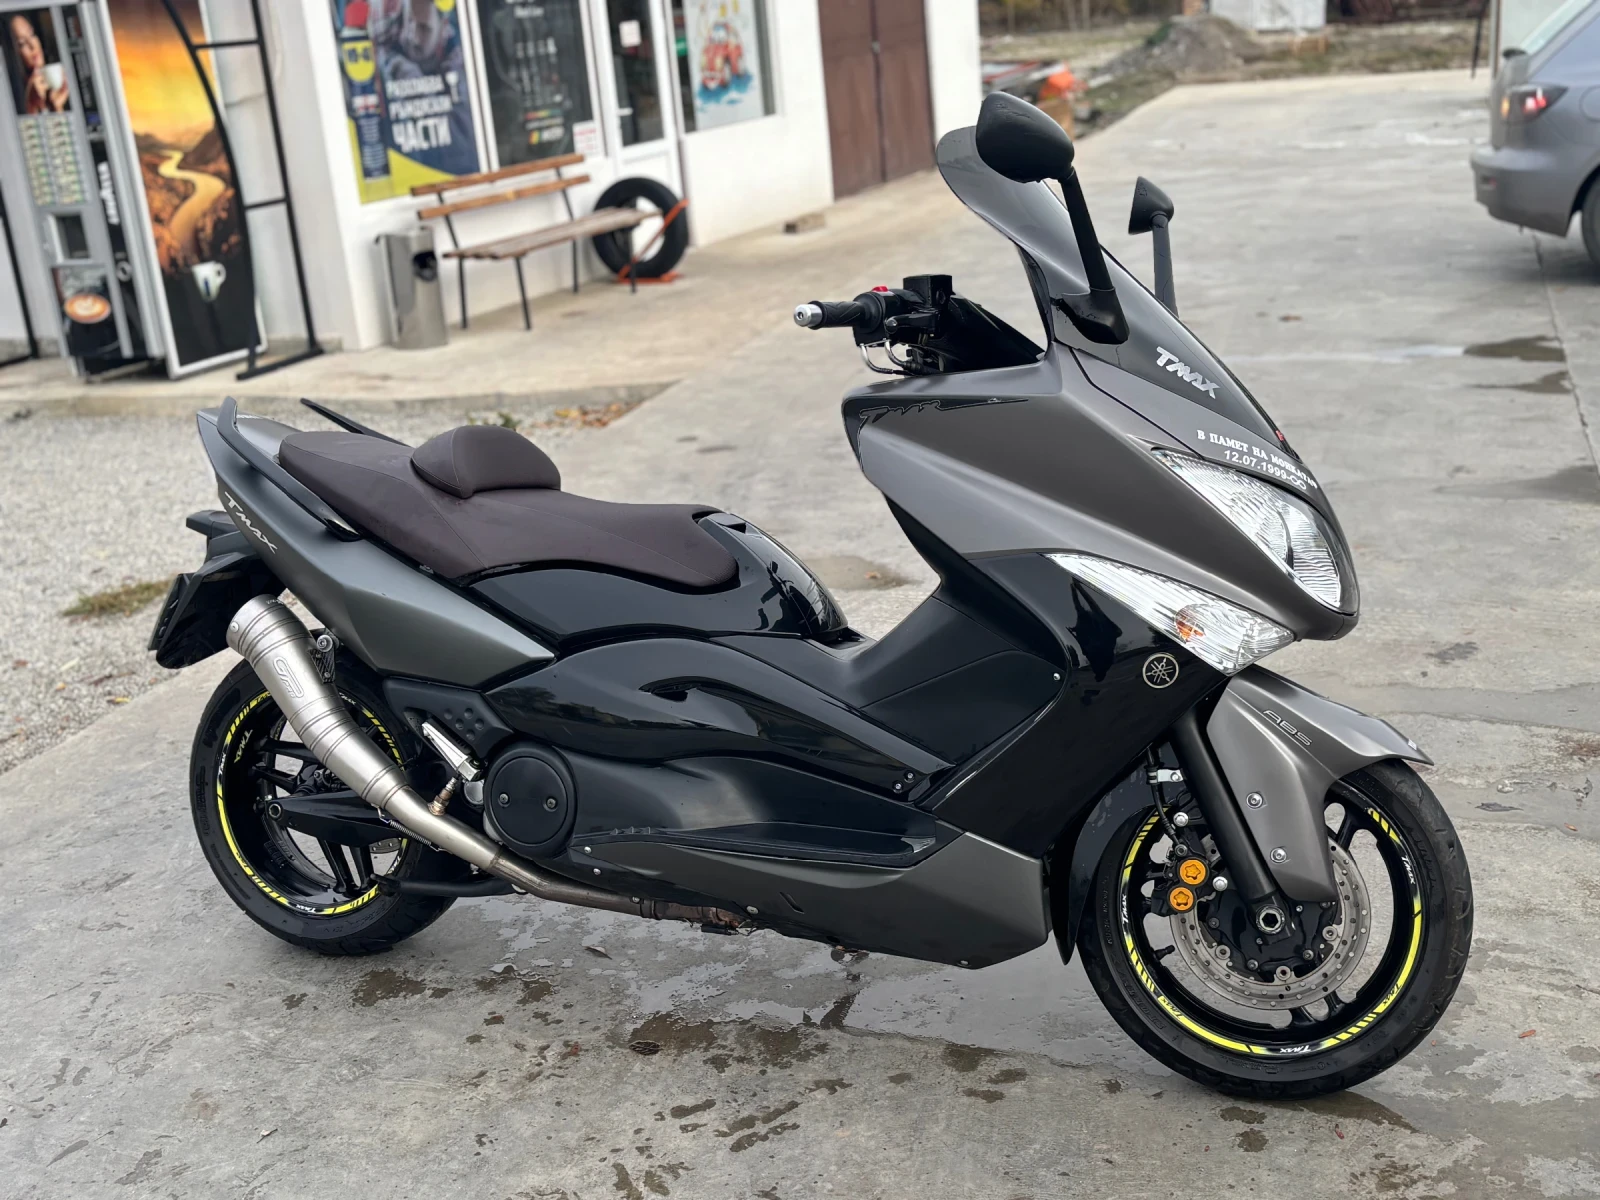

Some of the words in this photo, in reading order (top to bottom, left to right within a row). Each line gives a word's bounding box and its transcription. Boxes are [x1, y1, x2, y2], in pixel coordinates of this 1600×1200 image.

[392, 116, 452, 153] ЧАСТИ
[1156, 346, 1220, 399] TMAX
[1197, 429, 1206, 440] В
[1209, 432, 1248, 453] ПАМЕТ
[1251, 446, 1268, 460] НА
[225, 491, 278, 554] TMAX
[1263, 710, 1313, 746] ABS
